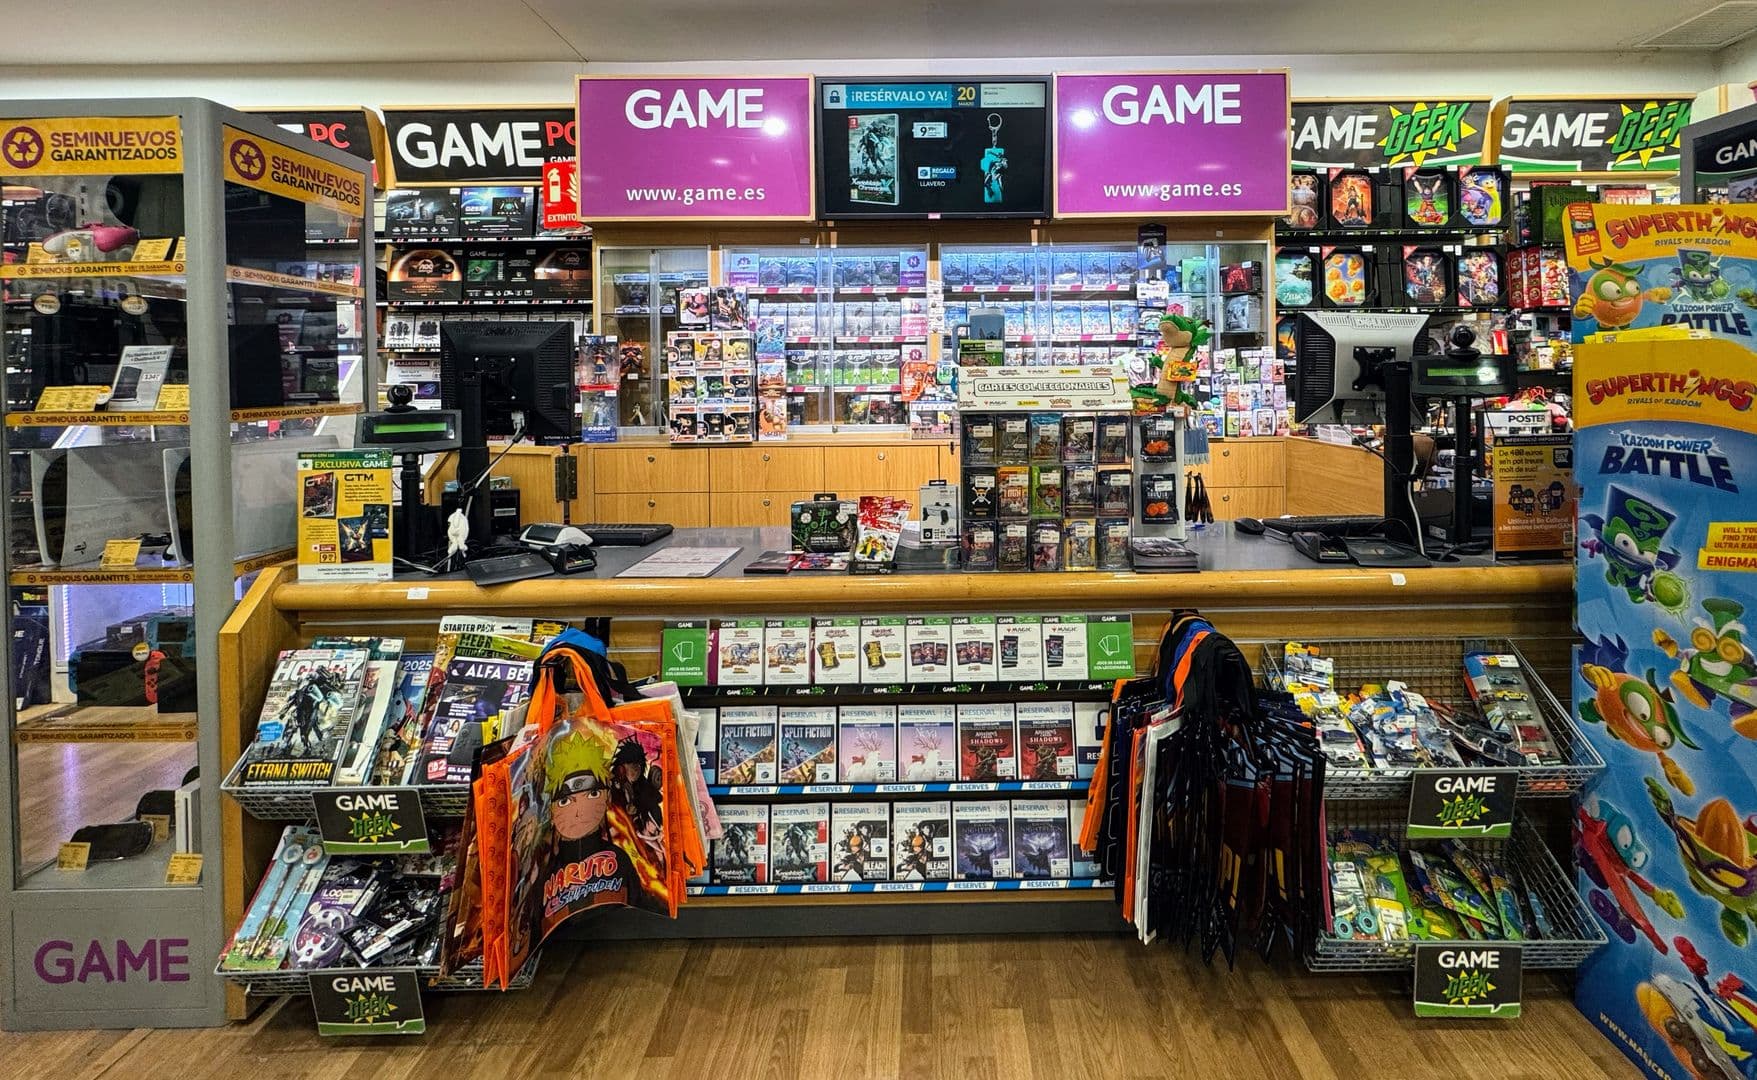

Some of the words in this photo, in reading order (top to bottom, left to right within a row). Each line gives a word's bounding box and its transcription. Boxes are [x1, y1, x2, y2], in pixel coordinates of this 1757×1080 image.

[851, 89, 925, 103] ¡RESÉRVALO
[927, 90, 948, 102] YA!
[957, 86, 976, 101] 20
[625, 88, 764, 129] GAME
[1102, 84, 1242, 126] GAME
[308, 123, 350, 149] PC
[1291, 114, 1378, 151] AME
[1384, 102, 1471, 157] GEEK
[1501, 112, 1609, 150] GAME
[50, 129, 176, 149] SEMINUEVOS
[396, 122, 545, 168] GAME
[50, 146, 177, 163] GARANTIZADOS
[1715, 139, 1757, 165] GA
[271, 155, 361, 196] SEMINUEVOS
[271, 170, 361, 207] GARANTIZADOS
[626, 187, 765, 205] www.game.es
[1103, 182, 1242, 201] www.game.es
[547, 214, 576, 223] EXTINTO
[1606, 206, 1757, 249] SUPERTHING
[1655, 238, 1682, 247] RIVALS
[1695, 238, 1731, 246] KABOOM
[30, 266, 73, 275] SEMINOUS
[74, 265, 122, 274] GARANTITS
[1672, 303, 1704, 313] KAZOOM
[1706, 303, 1734, 312] POWER
[978, 383, 1016, 391] CARTES
[1586, 369, 1757, 412] SUPERTHINGS
[1627, 398, 1653, 406] RIVALS
[1664, 399, 1702, 408] KABOOM
[1508, 414, 1546, 423] POSTER
[1619, 432, 1665, 449] KAZOOM
[1666, 438, 1713, 454] POWER
[315, 461, 361, 469] EXCLUSIVA
[362, 460, 389, 468] GAME
[1598, 445, 1739, 494] BATTLE
[344, 473, 374, 481] GTM
[1706, 556, 1757, 569] ENIGMA
[443, 623, 475, 632] STARTER
[403, 660, 432, 671] 2025
[465, 664, 501, 680] ALFA
[507, 668, 533, 681] BET
[725, 727, 743, 738] SPLIT
[745, 726, 772, 737] FICTION
[785, 727, 803, 738] SPLIT
[805, 727, 831, 738] FICTION
[247, 763, 288, 779] ETERNA
[289, 762, 333, 778] SWITCH
[1434, 776, 1496, 793] GAME
[336, 794, 399, 811] GAME
[1440, 797, 1485, 821] GEEK
[351, 814, 394, 838] GEEK
[543, 856, 618, 906] NARUTO
[881, 883, 914, 891] RESERVES
[1027, 880, 1060, 888] RESERVES
[321, 889, 344, 898] LOO
[559, 878, 623, 905] SHIPPUDEN
[34, 938, 190, 984] GAME
[1438, 950, 1499, 969] GAME
[332, 975, 397, 993] GAME
[1446, 973, 1491, 1001] GEEK
[348, 995, 390, 1019] GEEK
[1600, 1012, 1673, 1080] WWW.MAGICBO
